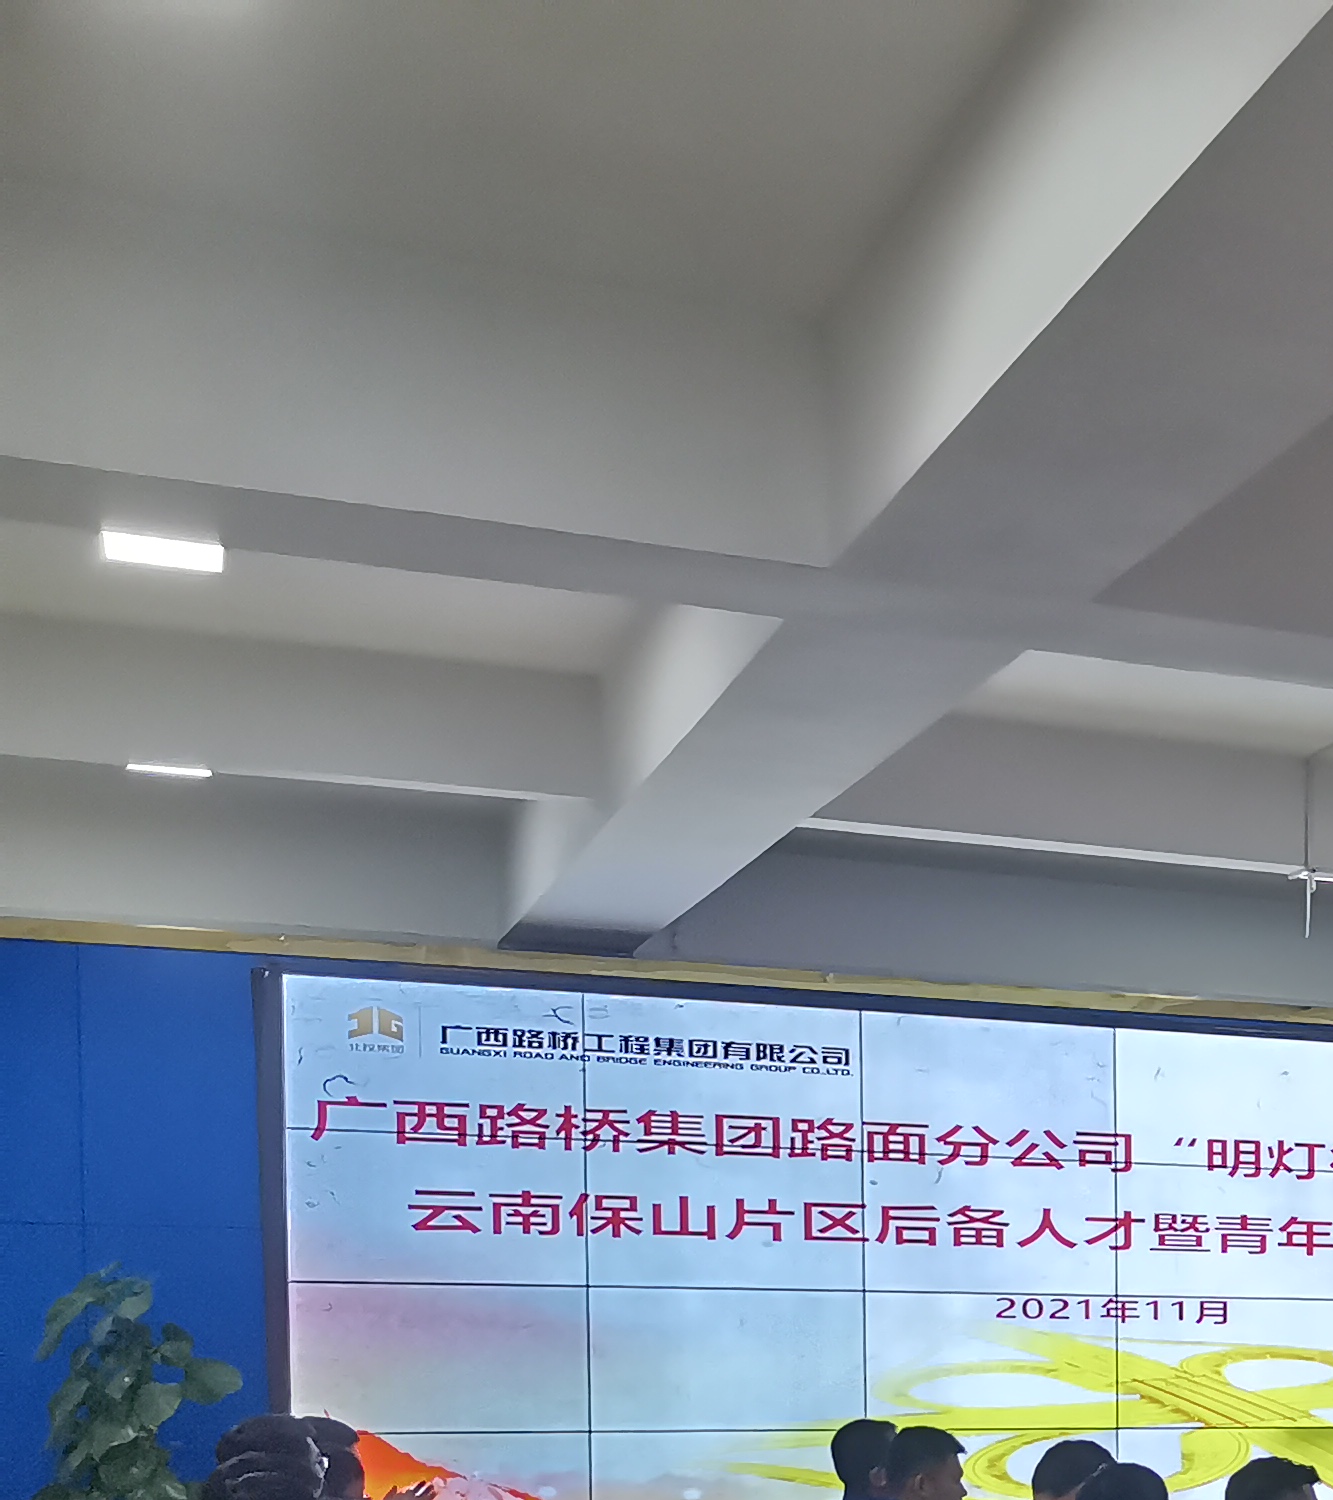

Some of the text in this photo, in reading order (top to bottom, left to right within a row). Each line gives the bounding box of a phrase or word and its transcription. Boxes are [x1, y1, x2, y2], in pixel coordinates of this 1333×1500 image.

[440, 1025, 850, 1067] 广西路桥工程集团有限公司
[440, 1047, 507, 1058] GUANGXI
[513, 1051, 554, 1060] ROAD
[559, 1053, 590, 1062] AND
[596, 1055, 647, 1066] BRIDGE
[750, 1063, 796, 1073] GROUP
[310, 1096, 1134, 1174] 广西路桥集团路面分公司
[996, 1298, 1228, 1325] 2021年11月
